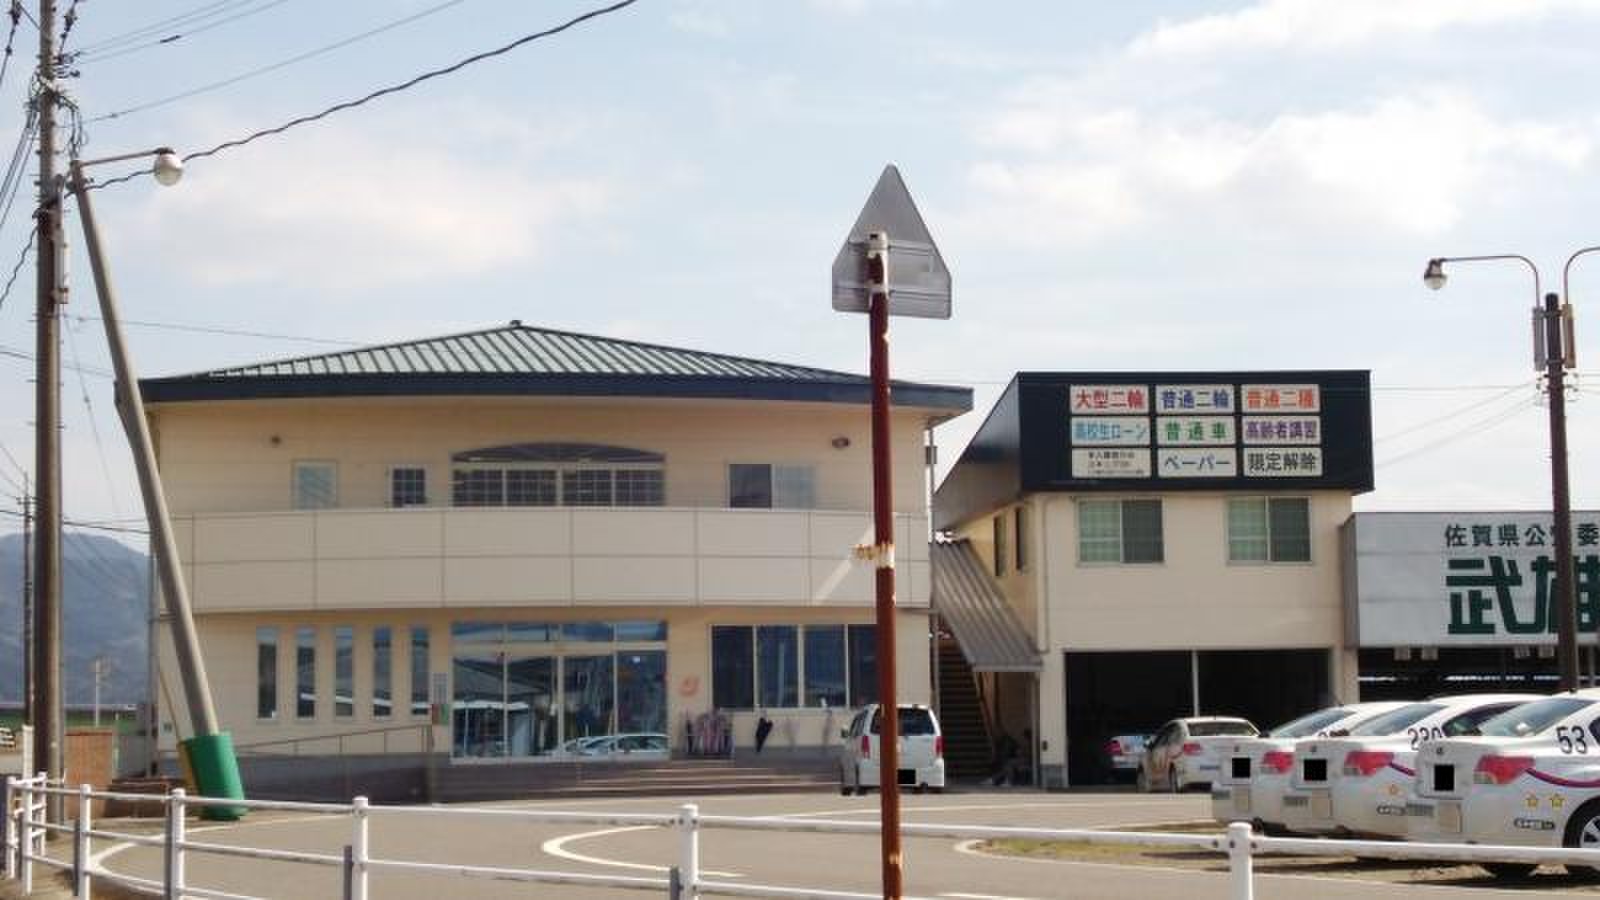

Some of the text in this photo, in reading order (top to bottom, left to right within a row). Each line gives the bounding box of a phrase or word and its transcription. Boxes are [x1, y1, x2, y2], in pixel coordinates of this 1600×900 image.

[1076, 390, 1145, 409] 大型二輪
[1162, 389, 1229, 409] 普通二輪
[1075, 423, 1148, 440] 高校生ローン
[1165, 422, 1227, 441] 普通車
[1245, 420, 1317, 440] 高齢者講習
[1164, 455, 1231, 470] ペーパー
[1250, 453, 1317, 472] 限定解除
[1445, 524, 1600, 547] 佐賀県公委
[1556, 725, 1587, 754] 53
